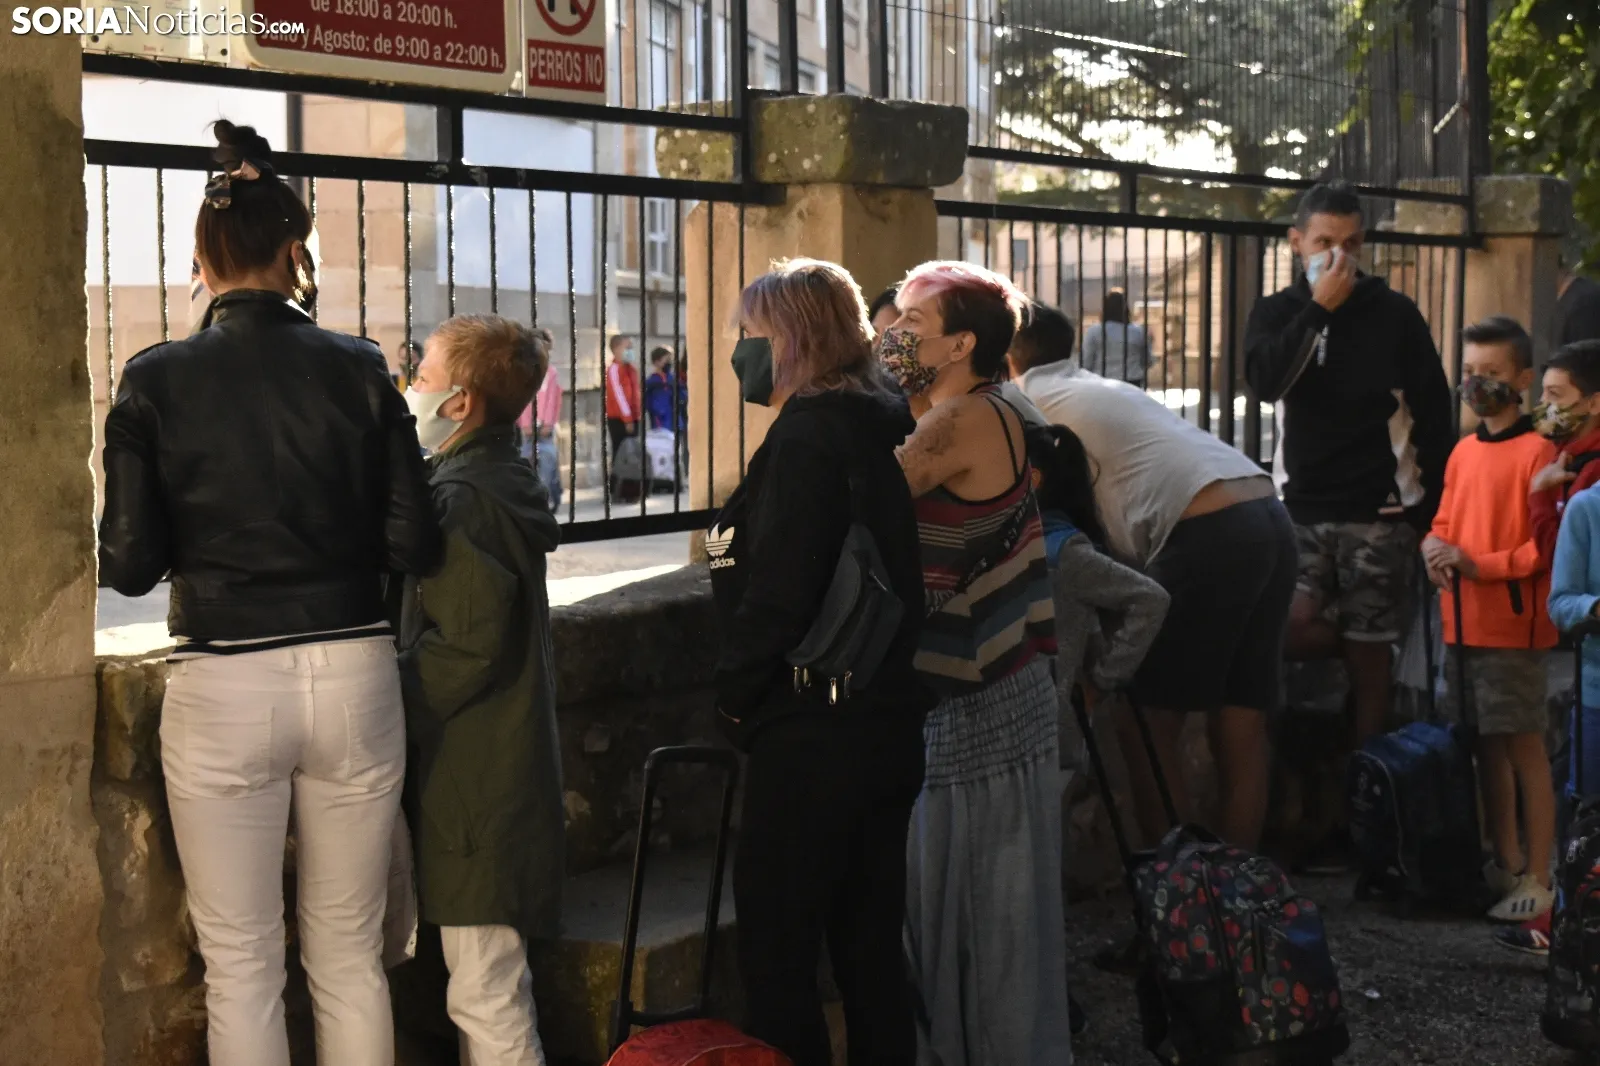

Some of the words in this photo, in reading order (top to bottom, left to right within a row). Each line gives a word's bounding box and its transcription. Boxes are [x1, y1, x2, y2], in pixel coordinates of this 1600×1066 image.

[310, 0, 331, 12] de
[336, 0, 379, 18] 18:00
[383, 3, 392, 20] a
[398, 1, 441, 27] 20:00
[444, 7, 458, 29] h.
[302, 27, 310, 49] y
[313, 24, 370, 53] Agosto:
[374, 33, 392, 54] de
[395, 34, 430, 59] 9:00
[433, 45, 442, 60] a
[445, 41, 488, 66] 22:00
[491, 47, 504, 68] h.
[529, 47, 582, 84] PERROS
[585, 53, 603, 86] NO
[709, 557, 735, 569] adidas
